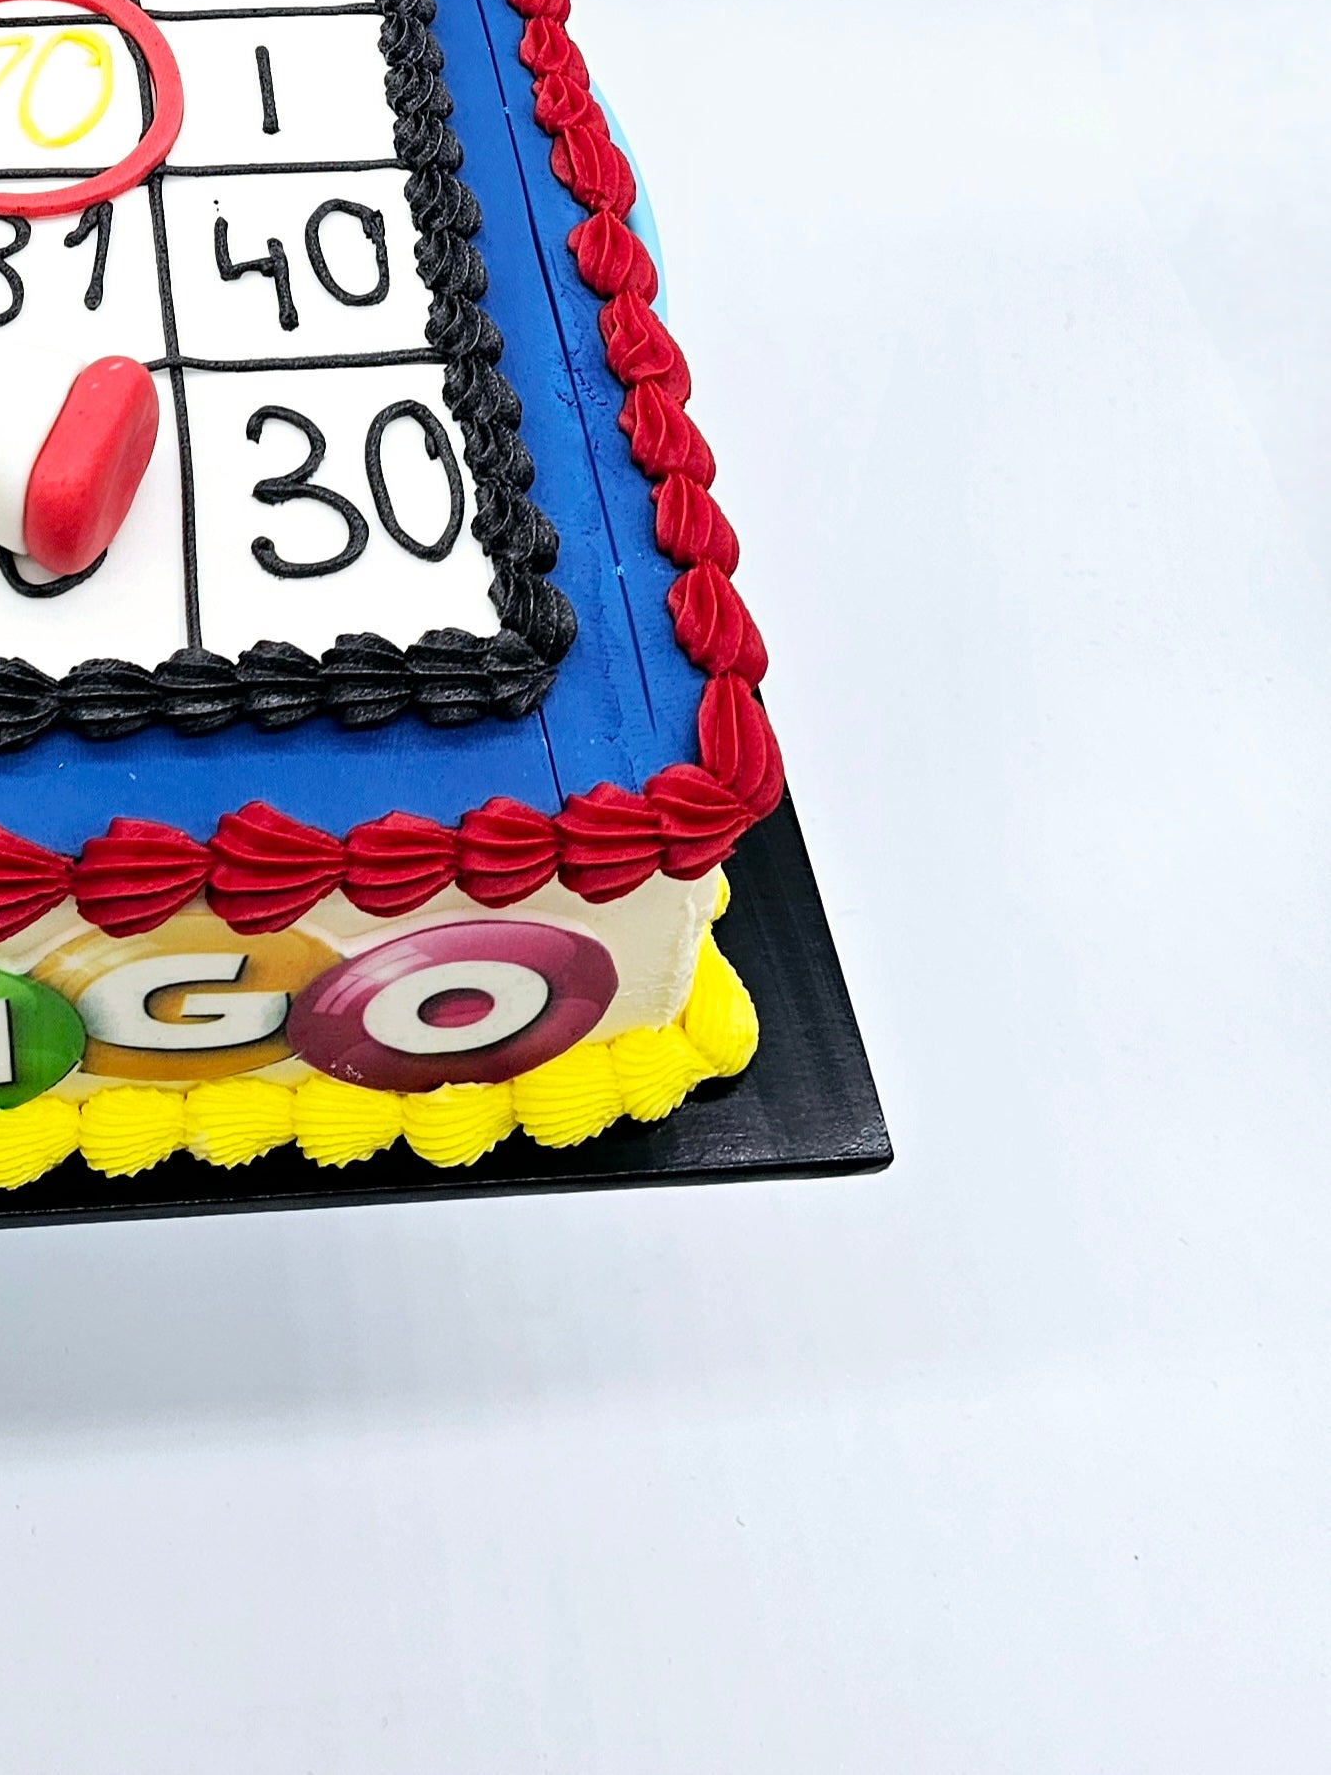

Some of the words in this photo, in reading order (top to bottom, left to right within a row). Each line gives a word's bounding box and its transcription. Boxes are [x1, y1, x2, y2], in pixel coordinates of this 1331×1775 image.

[255, 46, 279, 135] 1
[214, 199, 389, 331] 40
[246, 399, 466, 579] 30
